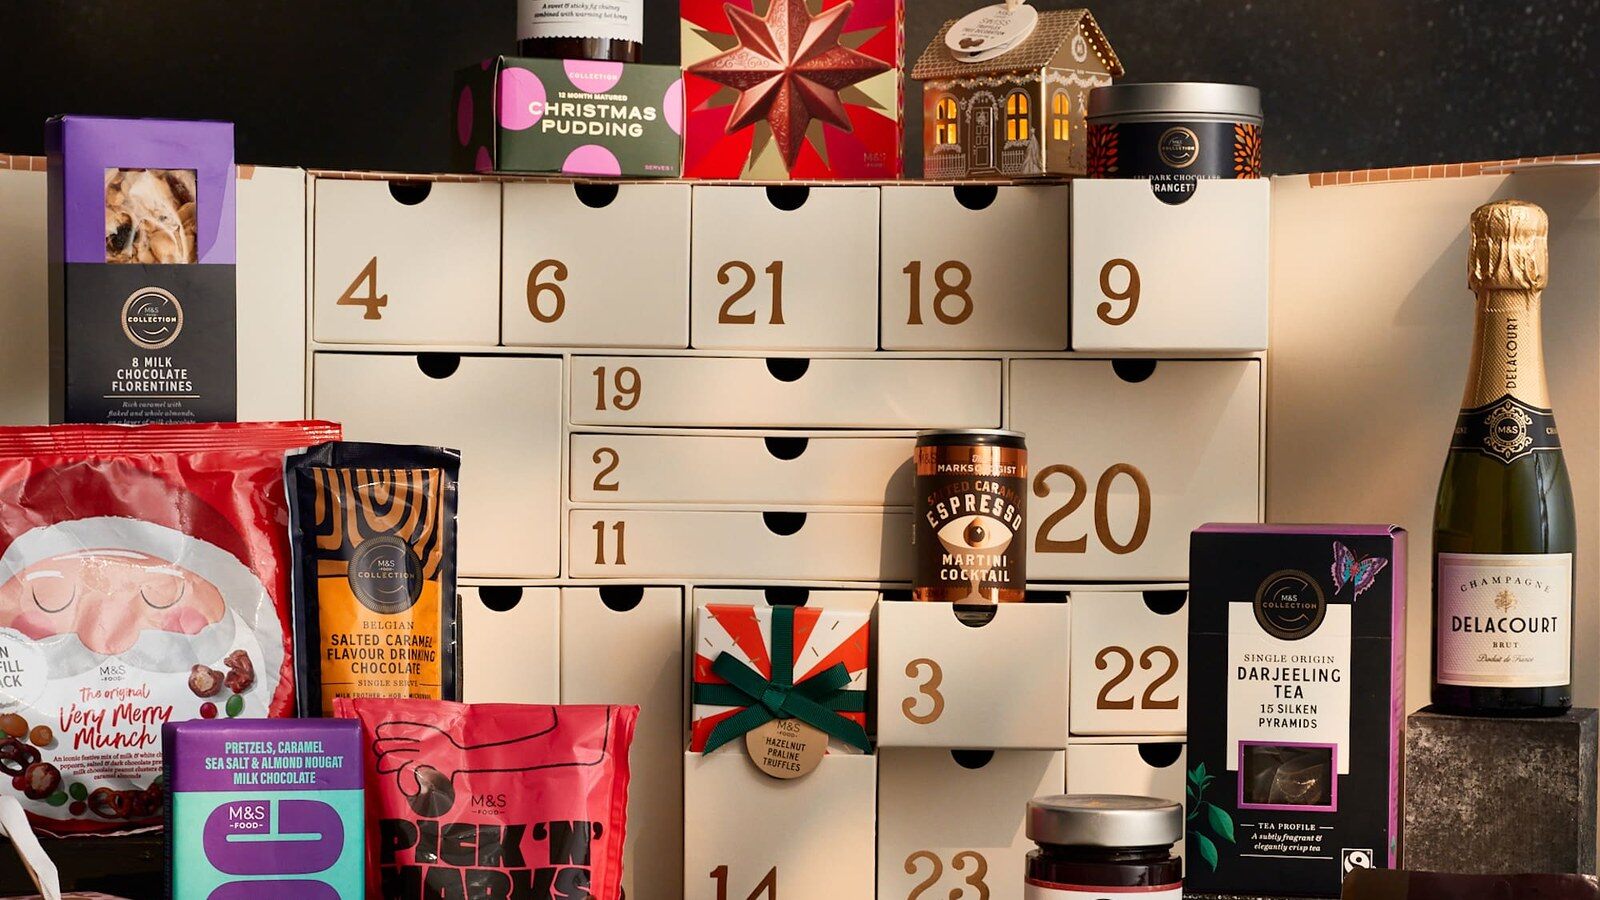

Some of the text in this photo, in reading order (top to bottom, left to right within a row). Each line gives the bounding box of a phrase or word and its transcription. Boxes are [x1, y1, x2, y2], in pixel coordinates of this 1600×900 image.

[569, 72, 618, 80] COLLECTION
[594, 94, 628, 102] MATURED
[528, 101, 657, 121] CHRISTMAS
[541, 119, 644, 138] PUDDING
[336, 255, 388, 320] 4
[526, 258, 568, 324] 6
[716, 260, 786, 325] 21
[902, 260, 974, 325] 18
[1096, 258, 1141, 326] 9
[1505, 318, 1518, 389] DELACOURT
[132, 357, 172, 367] 8 MILK
[117, 369, 188, 380] CHOCOLATE
[112, 381, 193, 392] FLORENTINES
[592, 366, 642, 411] 19
[122, 400, 182, 408] Rich caramel with
[107, 410, 129, 418] flaked
[1498, 425, 1518, 434] M&S
[592, 447, 620, 491] 2
[926, 493, 1022, 532] ESPRESSO
[1032, 462, 1152, 555] 20
[592, 520, 627, 565] 11
[942, 554, 1007, 568] MARTINI
[357, 571, 415, 579] COLLECTION
[940, 569, 1010, 583] COCKTAIL
[1460, 576, 1551, 594] CHAMPAGNE
[363, 621, 415, 630] BELGIAN
[1452, 616, 1558, 634] DELACOURT
[331, 633, 433, 648] SALTED CARAMEL
[327, 648, 436, 662] FLAVOUR DRINKING
[1244, 653, 1335, 664] SINGLE ORIGIN
[100, 665, 126, 676] M&S
[351, 662, 421, 675] CHOCOLATE
[1237, 666, 1341, 683] DARJEELING
[1095, 645, 1180, 710] 22
[80, 683, 151, 703] The original
[901, 657, 945, 725] 3
[1273, 685, 1304, 699] TEA
[1260, 703, 1318, 715] 15 SILKEN
[60, 703, 173, 733] Very Merry
[1258, 718, 1318, 729] PYRAMIDS
[777, 720, 801, 733] M&S
[73, 725, 157, 750] Munch
[765, 737, 807, 752] HAZELNUT
[225, 741, 324, 755] PRETZELS, CARAMEL
[767, 748, 800, 761] PRALINE
[205, 756, 344, 770] SEA SALT & ALMOND NOUGAT
[763, 757, 801, 772] TRUFFLES
[86, 767, 113, 775] chocolate
[233, 771, 316, 785] MILK CHOCOLATE
[471, 794, 507, 809] M&S
[229, 806, 265, 820] M&S
[1258, 822, 1316, 831] TEA PROFILE
[379, 818, 527, 868] PICK
[1259, 833, 1282, 842] subtly
[1281, 833, 1314, 843] fragrant
[1315, 834, 1323, 842] &
[1254, 843, 1288, 852] elegantly
[1288, 844, 1308, 853] crisp
[904, 850, 990, 900] 23
[380, 865, 592, 900] MARKS
[709, 865, 777, 900] 14
